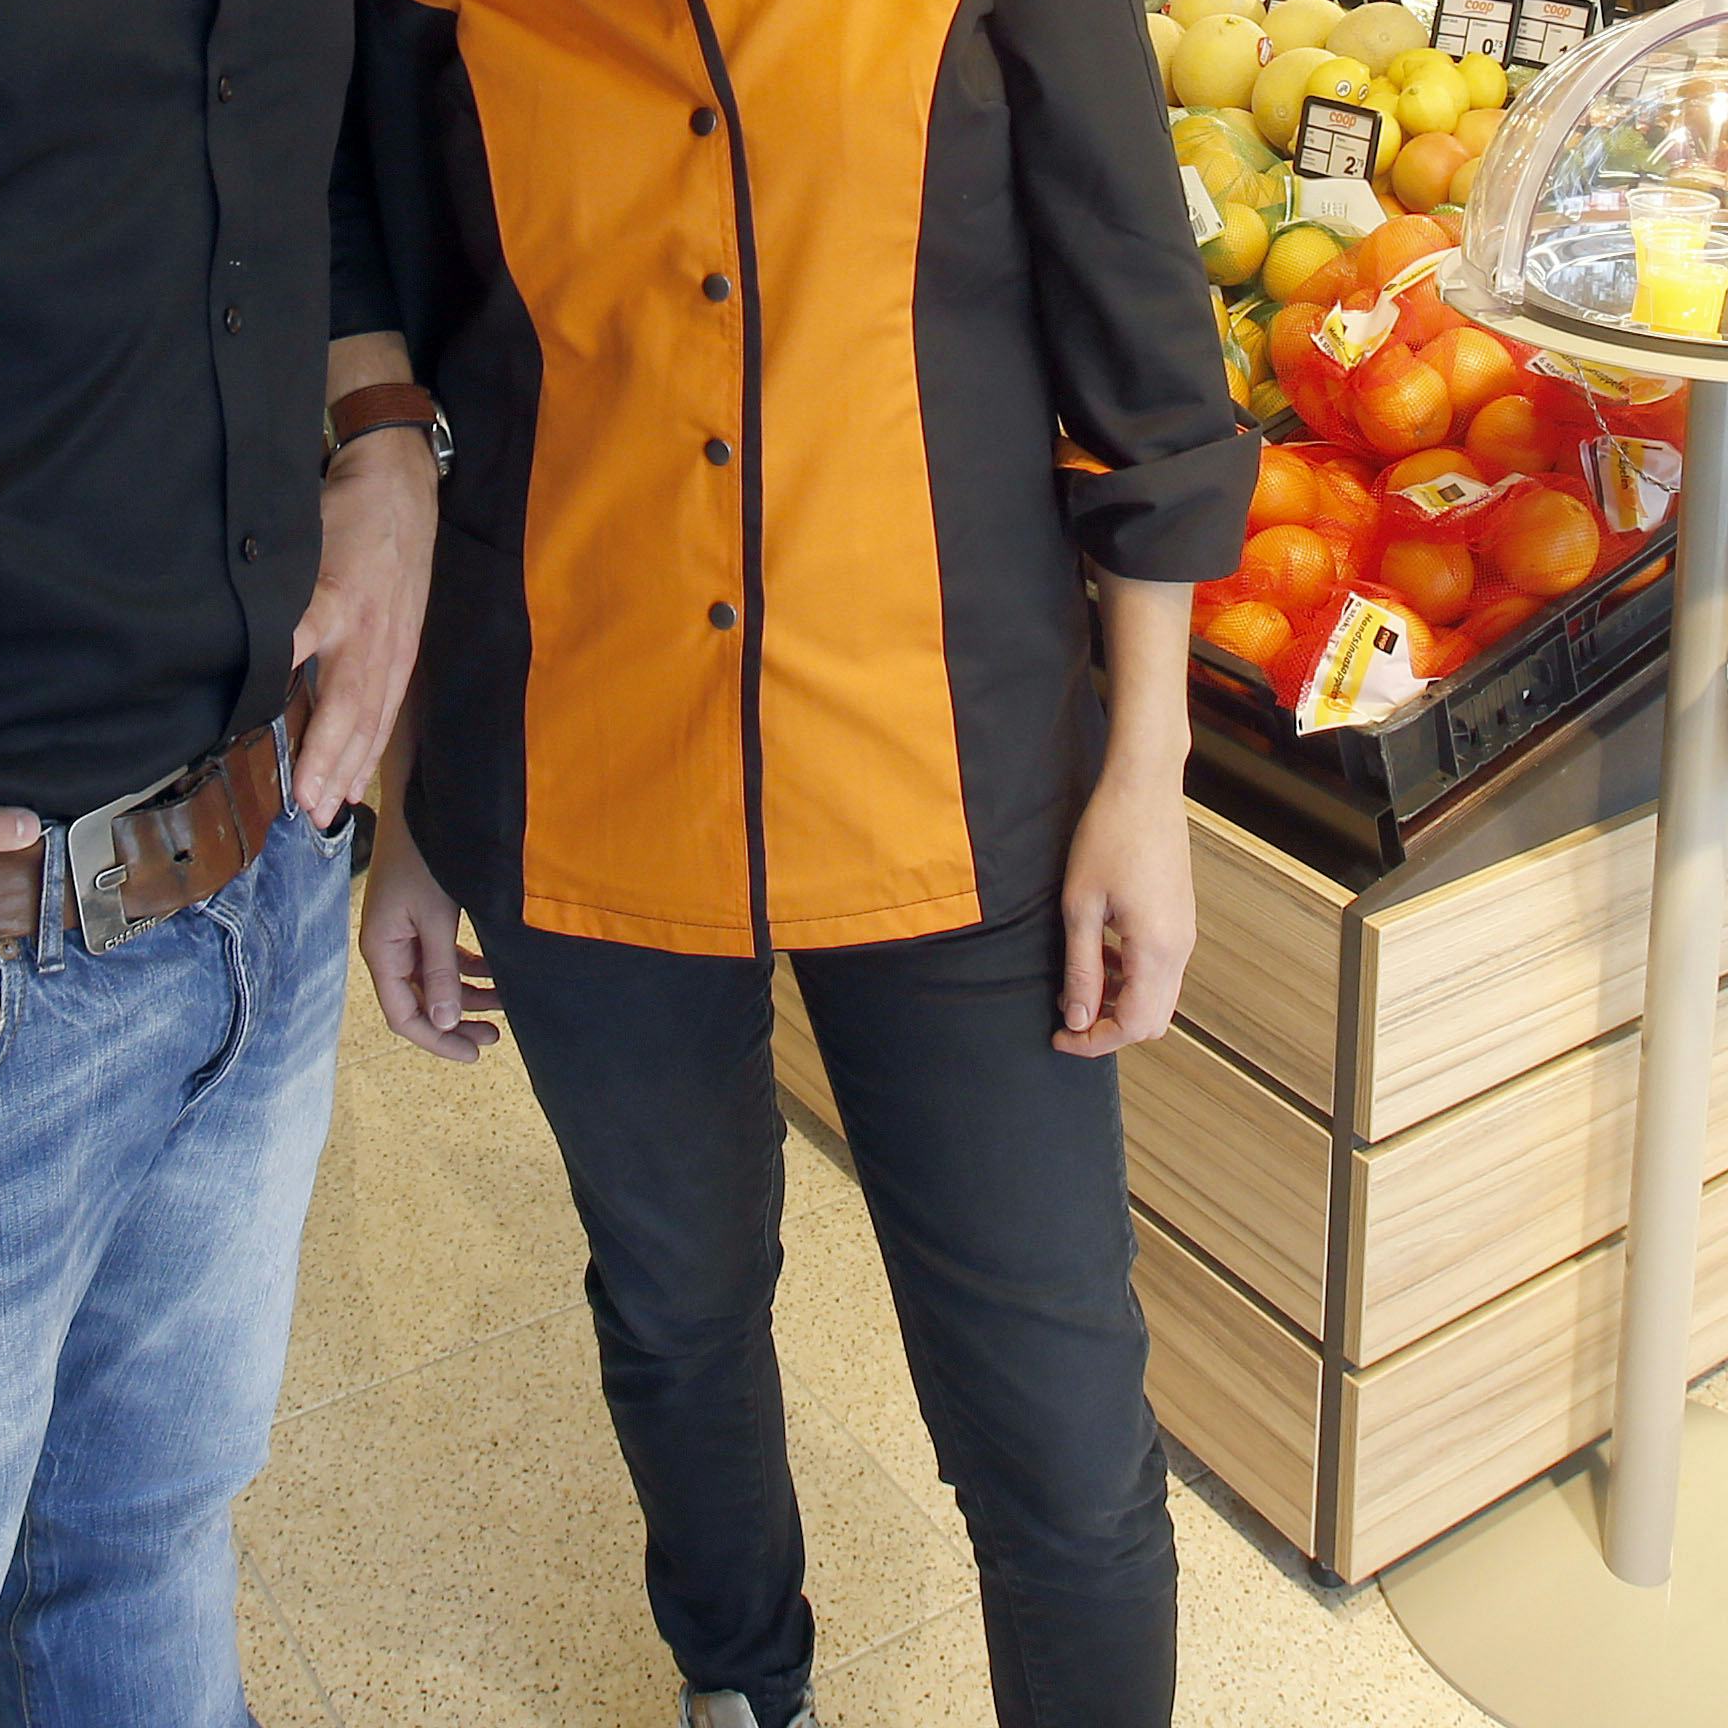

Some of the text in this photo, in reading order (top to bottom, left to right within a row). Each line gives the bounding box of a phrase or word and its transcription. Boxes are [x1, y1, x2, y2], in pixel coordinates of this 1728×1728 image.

[1464, 0, 1495, 15] coop
[1543, 3, 1572, 20] coop
[1328, 111, 1358, 129] coop
